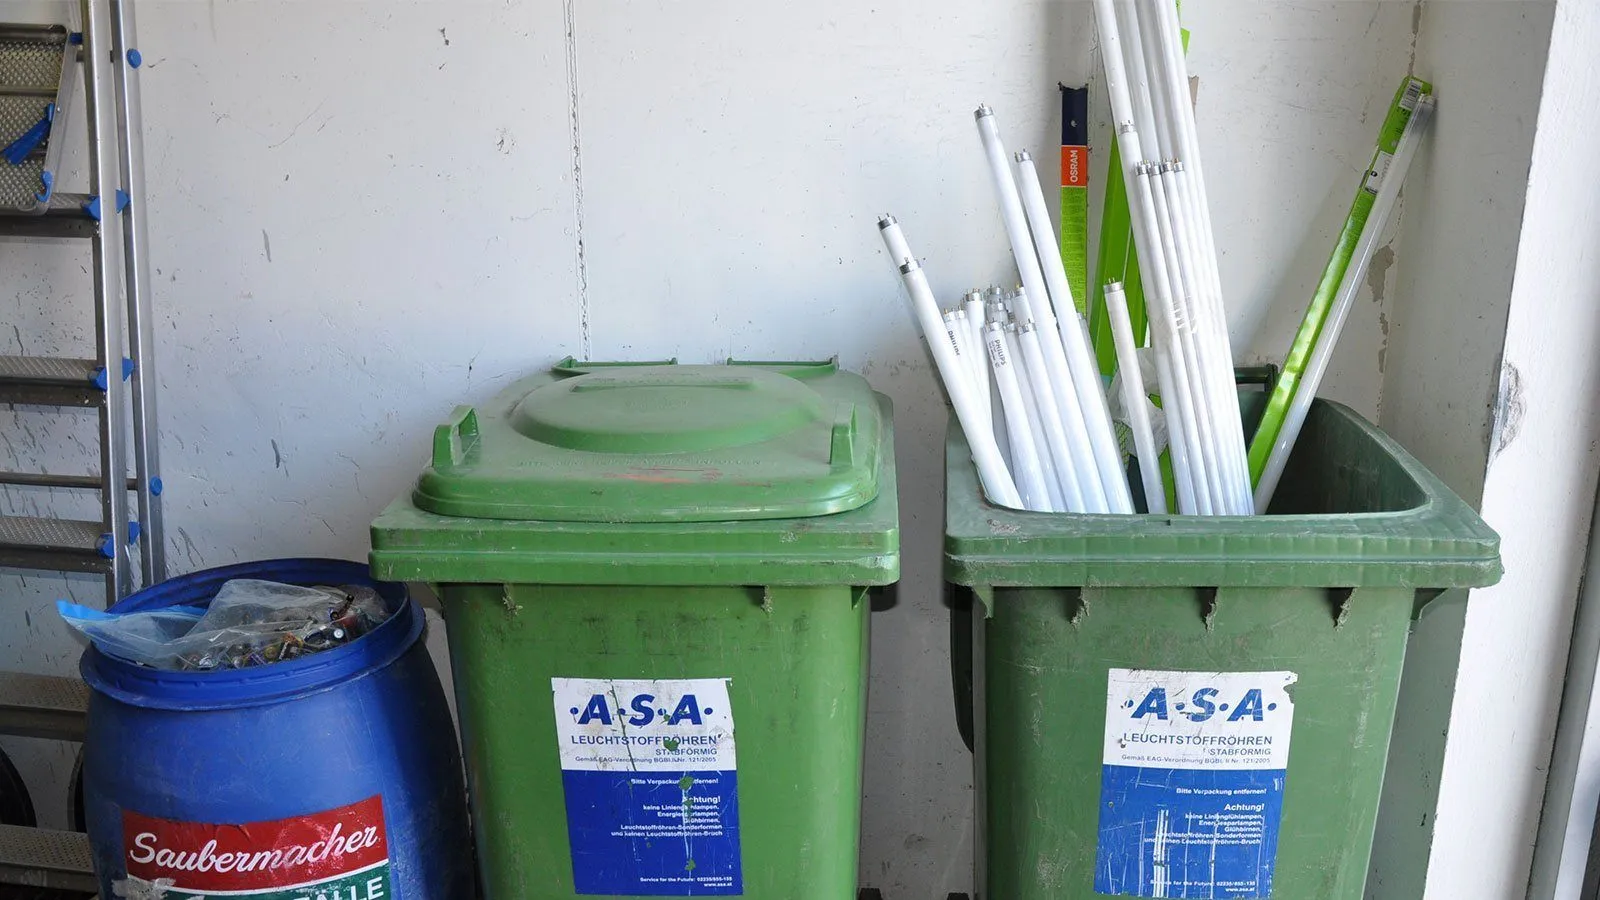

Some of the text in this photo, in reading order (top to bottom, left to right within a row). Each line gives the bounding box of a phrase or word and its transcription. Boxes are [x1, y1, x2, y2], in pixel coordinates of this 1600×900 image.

[1069, 149, 1079, 183] OSRAM
[994, 339, 1007, 366] PHILIPS
[1123, 733, 1273, 746] LEUCHTSTOFFRÖHREN
[1210, 747, 1271, 756] STABFÖRMIG
[1146, 755, 1203, 765] EAG-Verordnung
[647, 778, 680, 786] Verpackun
[1193, 788, 1232, 796] Verpackung
[1224, 803, 1265, 812] Achtung!
[130, 822, 379, 873] Saubermacher
